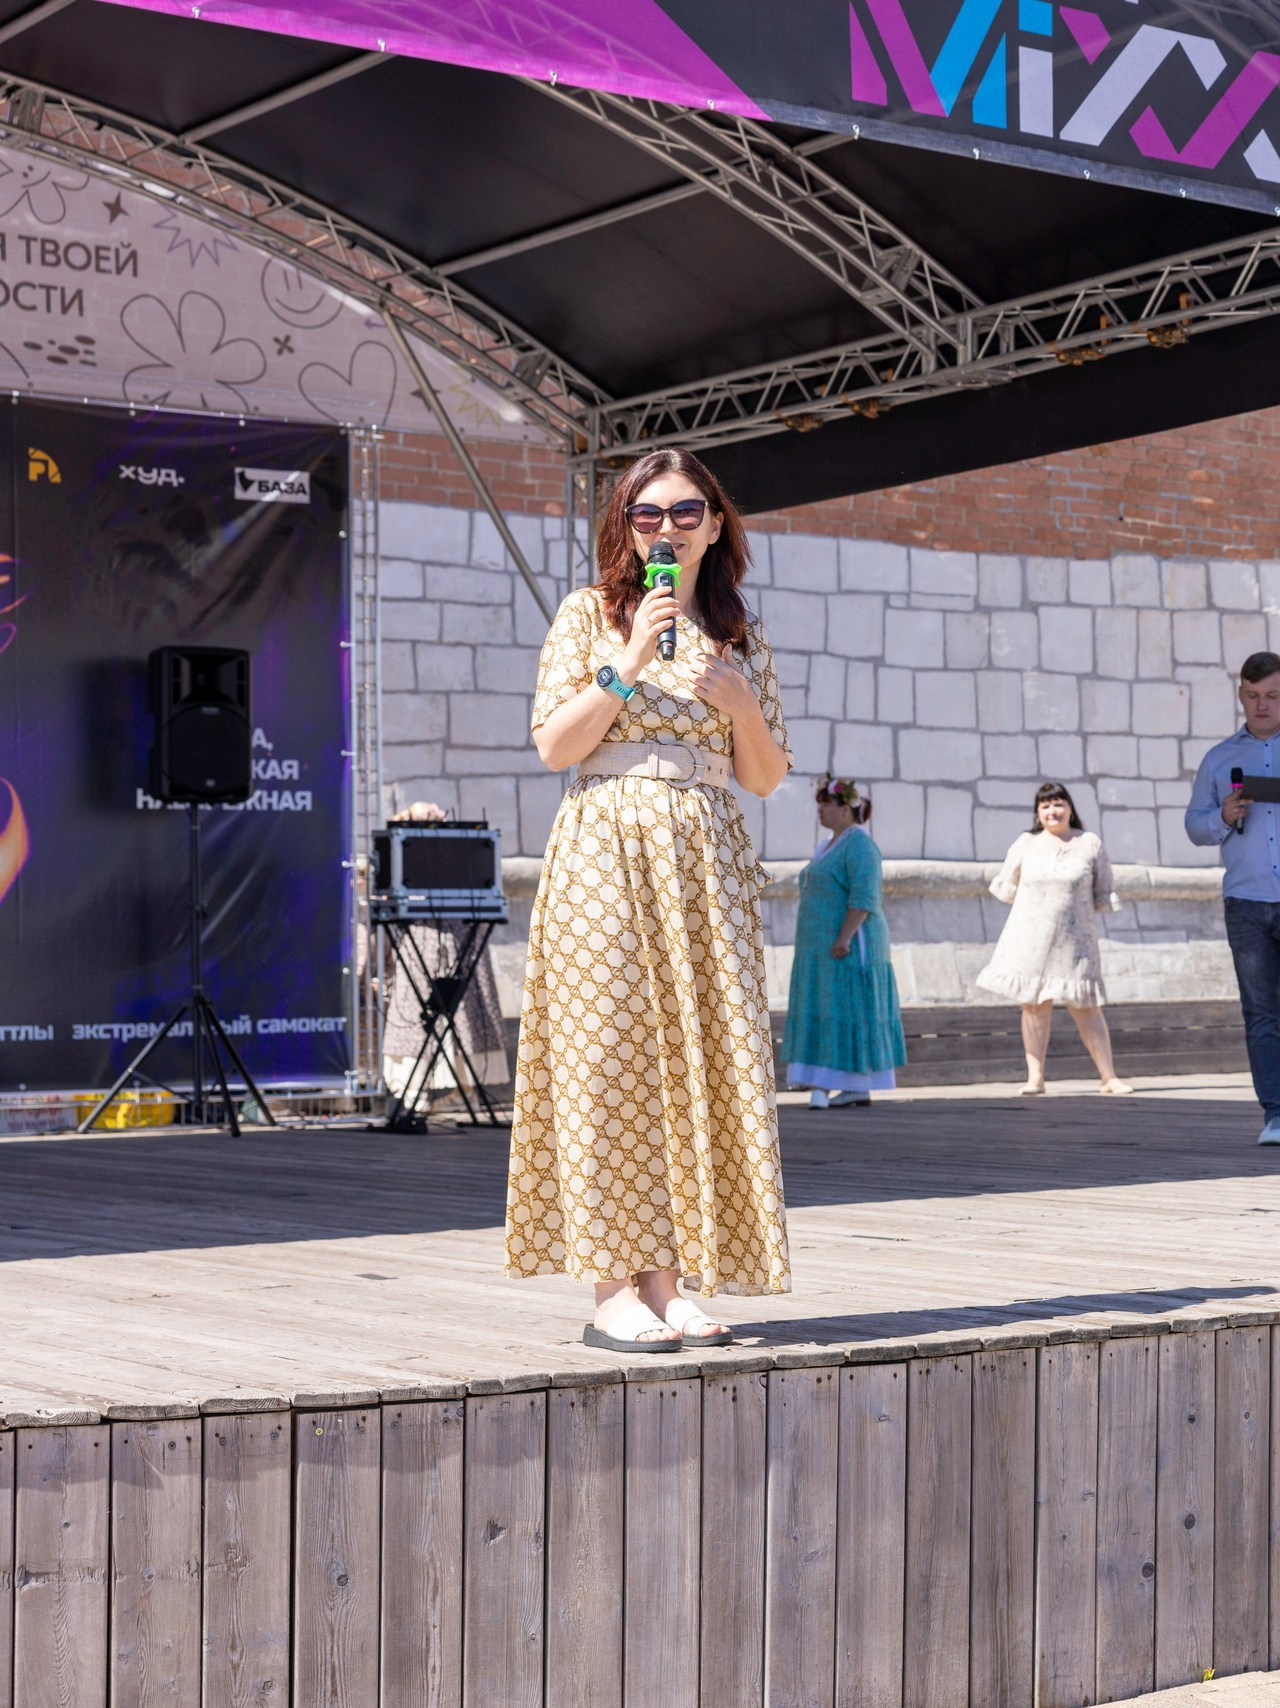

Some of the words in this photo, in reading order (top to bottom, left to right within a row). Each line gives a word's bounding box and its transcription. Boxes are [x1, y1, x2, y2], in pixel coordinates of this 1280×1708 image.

[18, 235, 138, 277] ТВОЕЙ
[258, 480, 307, 495] БАЗА
[72, 1015, 251, 1042] экстремалый
[257, 1016, 345, 1034] самокат
